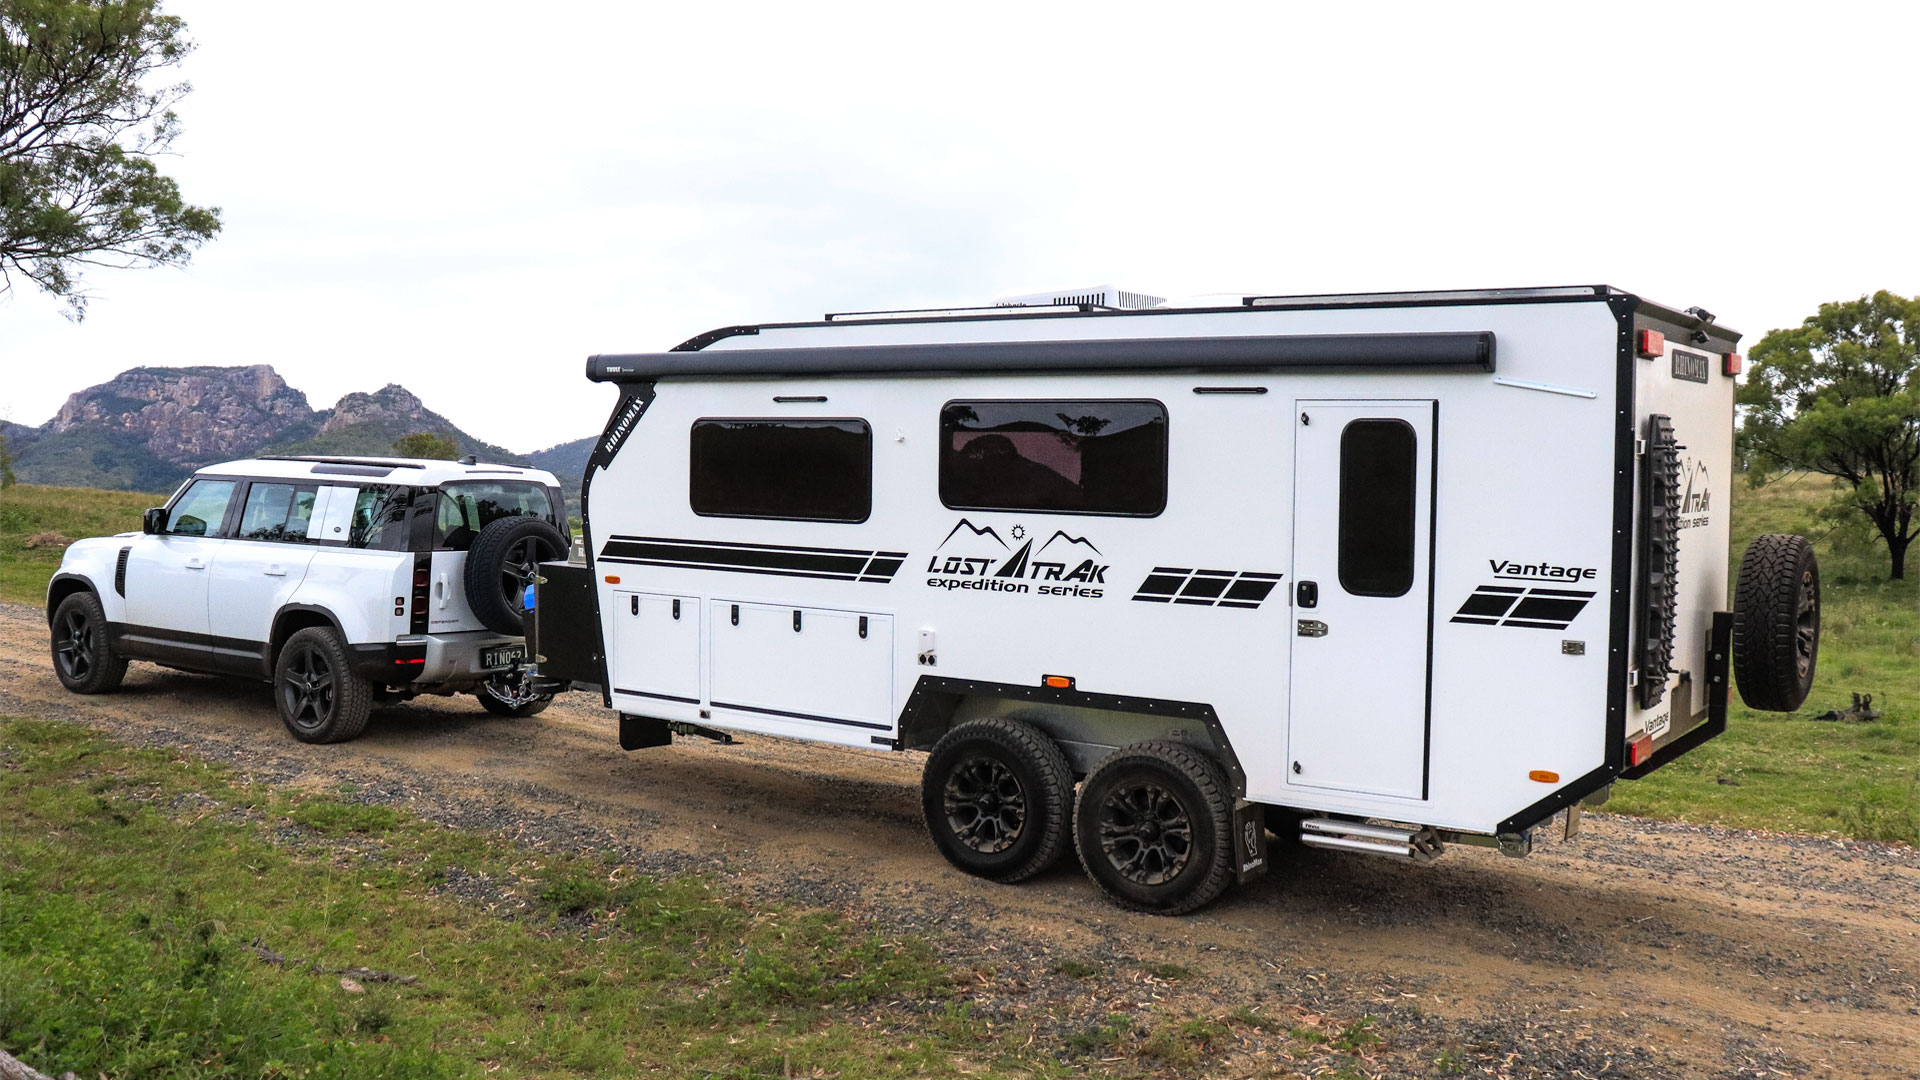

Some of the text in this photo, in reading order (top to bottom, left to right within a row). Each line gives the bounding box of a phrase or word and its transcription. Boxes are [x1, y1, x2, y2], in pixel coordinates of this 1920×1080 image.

[604, 398, 644, 453] RHINOMAX
[1691, 488, 1711, 512] TRAK
[927, 555, 1110, 584] LOST TRAK
[1489, 559, 1597, 583] Vantage
[927, 578, 1104, 598] expedition series
[1645, 711, 1669, 735] Vantage
